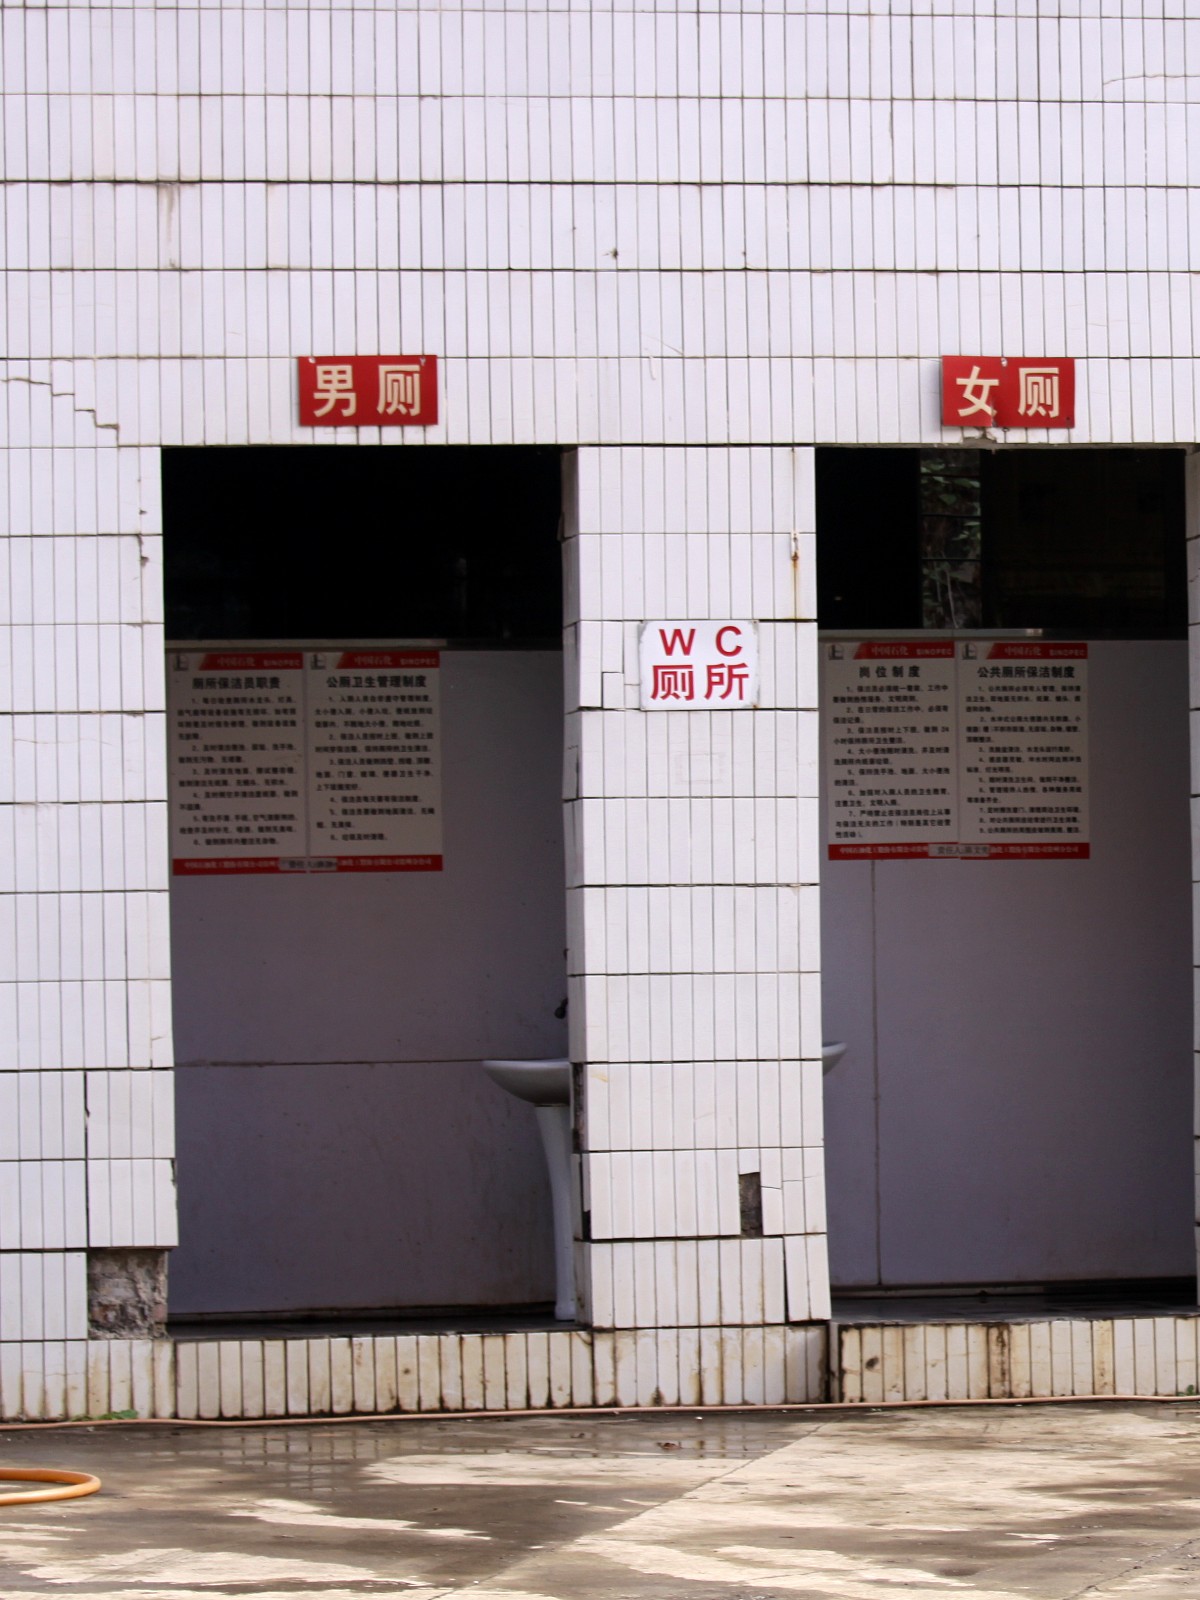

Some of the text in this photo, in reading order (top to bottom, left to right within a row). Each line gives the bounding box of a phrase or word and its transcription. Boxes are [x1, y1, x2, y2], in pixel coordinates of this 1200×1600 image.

[313, 364, 421, 418] 男厕
[955, 365, 1060, 418] 女厕
[650, 663, 750, 701] 厕所
[977, 666, 1075, 678] 公共厕所保洁制度
